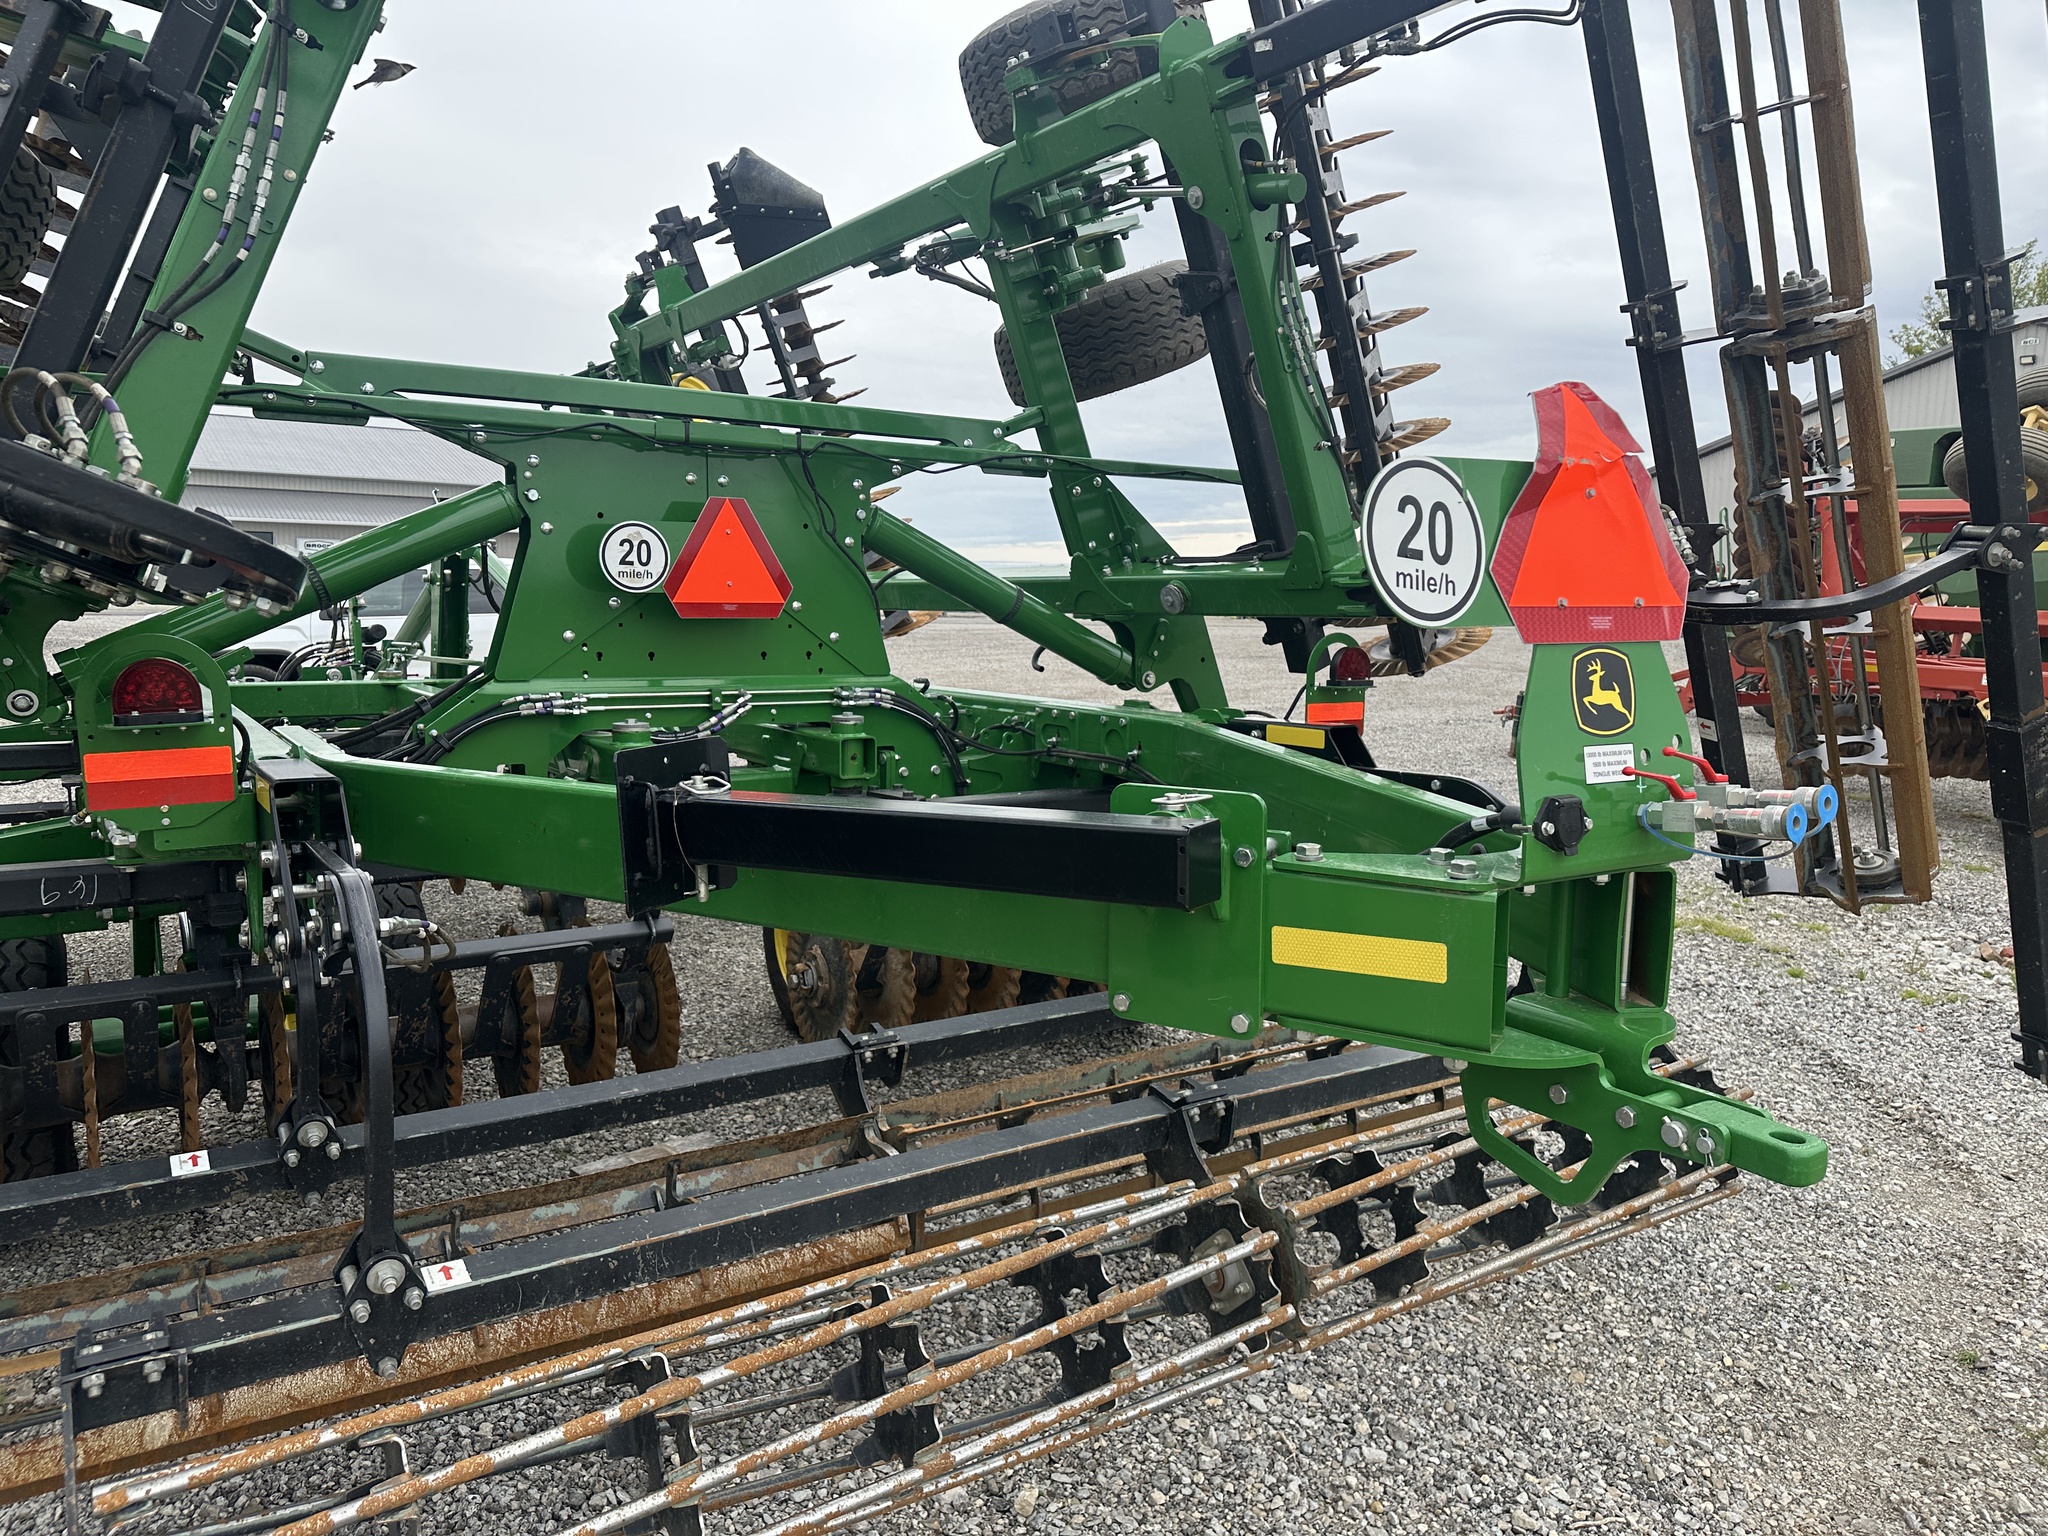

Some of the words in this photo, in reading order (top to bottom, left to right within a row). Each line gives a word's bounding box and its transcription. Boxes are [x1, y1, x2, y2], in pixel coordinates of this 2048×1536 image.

[1396, 494, 1453, 566] 20
[618, 538, 652, 567] 20
[618, 569, 653, 579] mile/h
[1396, 568, 1456, 596] mile/h
[1593, 770, 1611, 778] TONGUE
